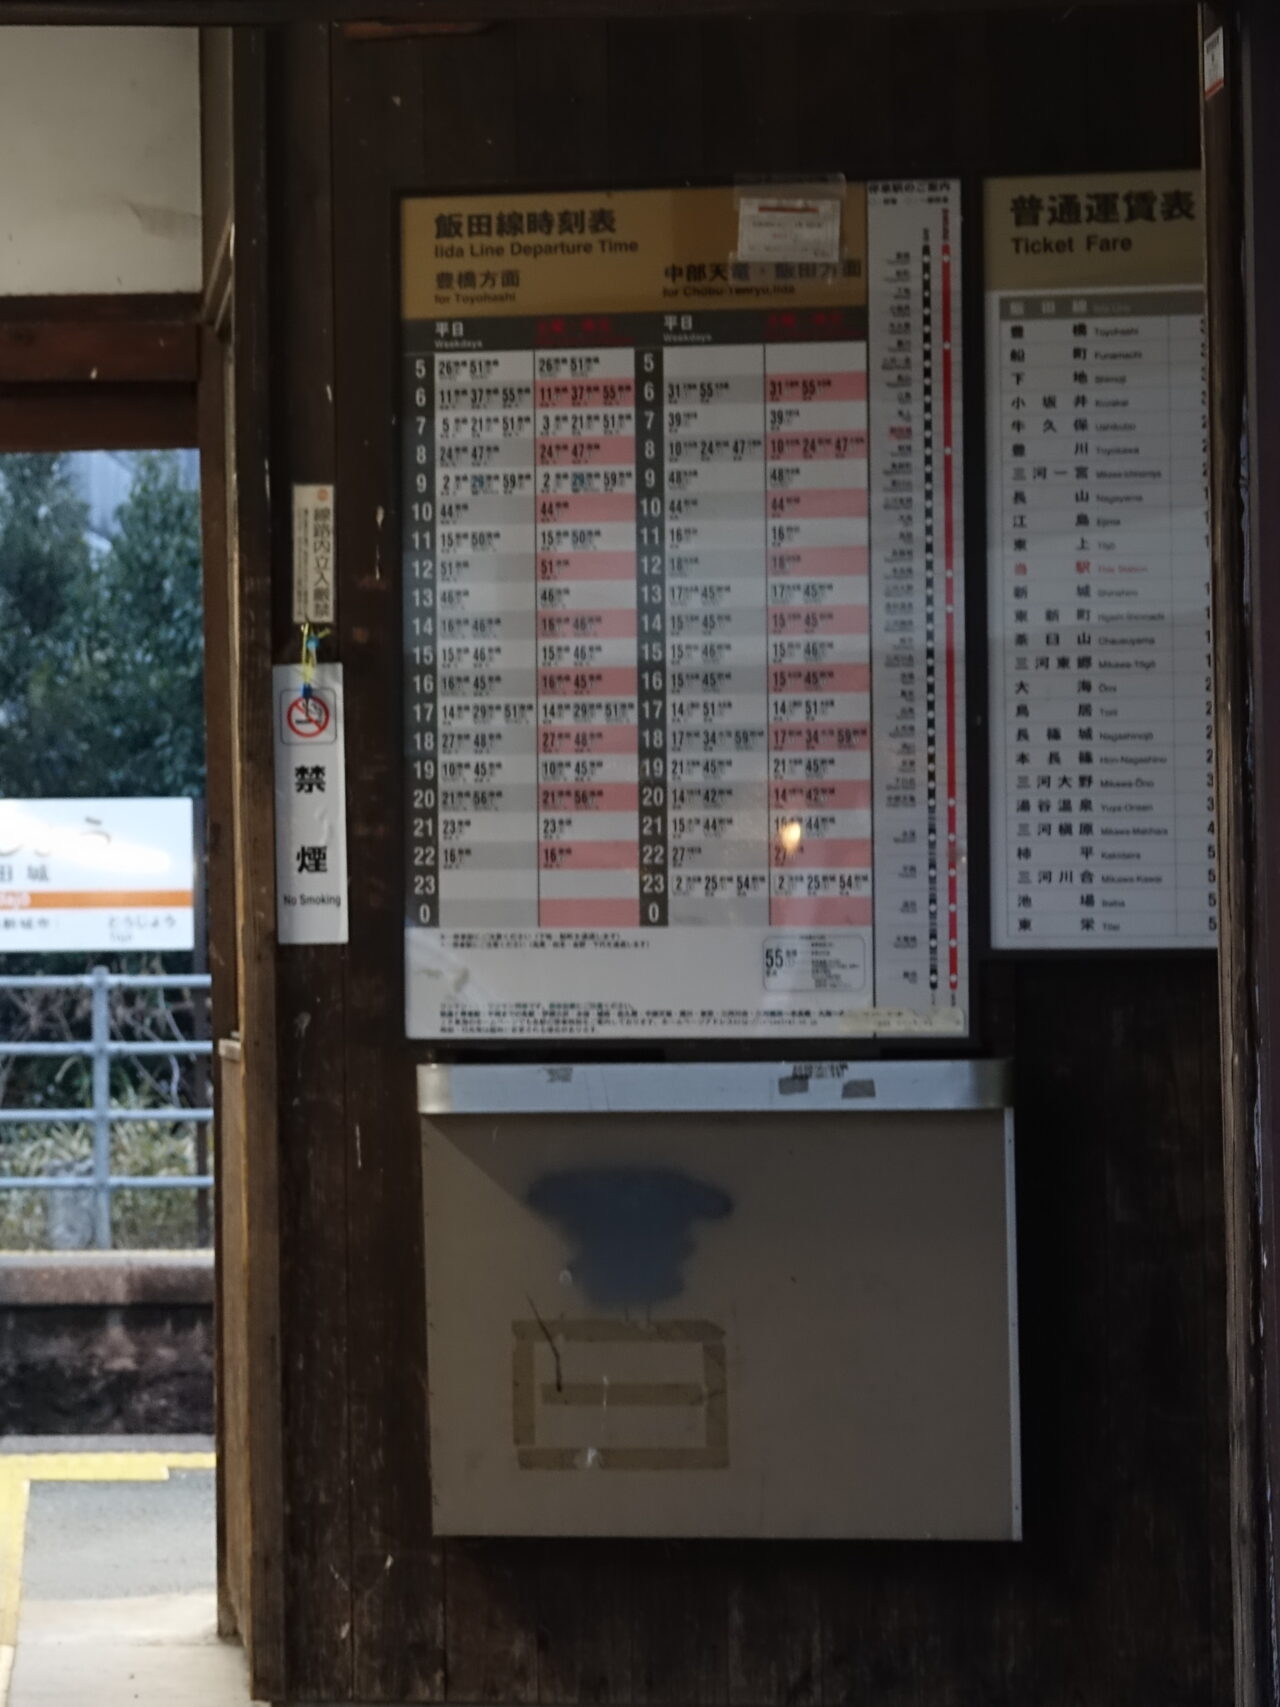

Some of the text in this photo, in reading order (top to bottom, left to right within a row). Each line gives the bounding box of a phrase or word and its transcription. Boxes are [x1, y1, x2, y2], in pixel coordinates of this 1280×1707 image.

[1010, 190, 1195, 228] 普通運賃表
[434, 207, 617, 240] 飯田線時刻表
[434, 238, 639, 258] Iida Line Departure Time
[1011, 234, 1133, 255] Ticket Fare
[435, 268, 520, 290] 豊橋方面
[434, 291, 516, 305] for Toyohashi
[435, 321, 464, 338] 平日
[664, 315, 693, 331] 平日
[415, 357, 583, 378] 5 26 51 26 51
[644, 353, 654, 371] 5
[416, 385, 616, 406] 6 11 37 55 37 55
[644, 382, 654, 401] 6
[416, 417, 426, 435] 7
[471, 417, 483, 431] 21
[502, 416, 515, 430] 51
[571, 415, 583, 429] 21
[603, 414, 615, 428] 51
[644, 410, 783, 429] 7 39 39
[416, 445, 426, 463] 8
[471, 446, 484, 460] 47
[645, 440, 655, 458] 8
[416, 474, 426, 492] 9
[503, 474, 516, 488] 59
[603, 472, 617, 486] 59
[645, 469, 655, 487] 9
[412, 503, 432, 520] 10
[641, 498, 661, 515] 10
[412, 532, 431, 549] 11
[641, 528, 660, 545] 11
[412, 561, 433, 578] 12
[641, 557, 661, 574] 12
[412, 590, 433, 607] 13
[641, 586, 661, 603] 13
[412, 618, 433, 636] 14
[642, 614, 661, 631] 14
[413, 646, 433, 664] 15
[642, 643, 662, 661] 15
[414, 675, 433, 693] 16
[642, 672, 662, 690] 16
[413, 704, 433, 722] 17
[442, 704, 454, 719] 14
[542, 703, 555, 718] 14
[642, 702, 662, 719] 17
[414, 732, 433, 749] 18
[643, 731, 663, 748] 18
[414, 761, 434, 779] 19
[474, 762, 487, 776] 45
[574, 761, 588, 776] 45
[643, 760, 663, 777] 19
[413, 789, 434, 809] 20
[643, 788, 663, 806] 20
[295, 766, 328, 874] 禁煙
[413, 818, 557, 837] 21 23 23
[642, 816, 662, 834] 21
[414, 847, 436, 866] 22
[642, 847, 664, 864] 22
[414, 876, 436, 895] 23
[643, 875, 664, 894] 23
[704, 875, 718, 890] 25
[736, 876, 750, 890] 54
[283, 894, 342, 907] No Smoking
[420, 906, 430, 922] 0
[649, 904, 659, 921] 0
